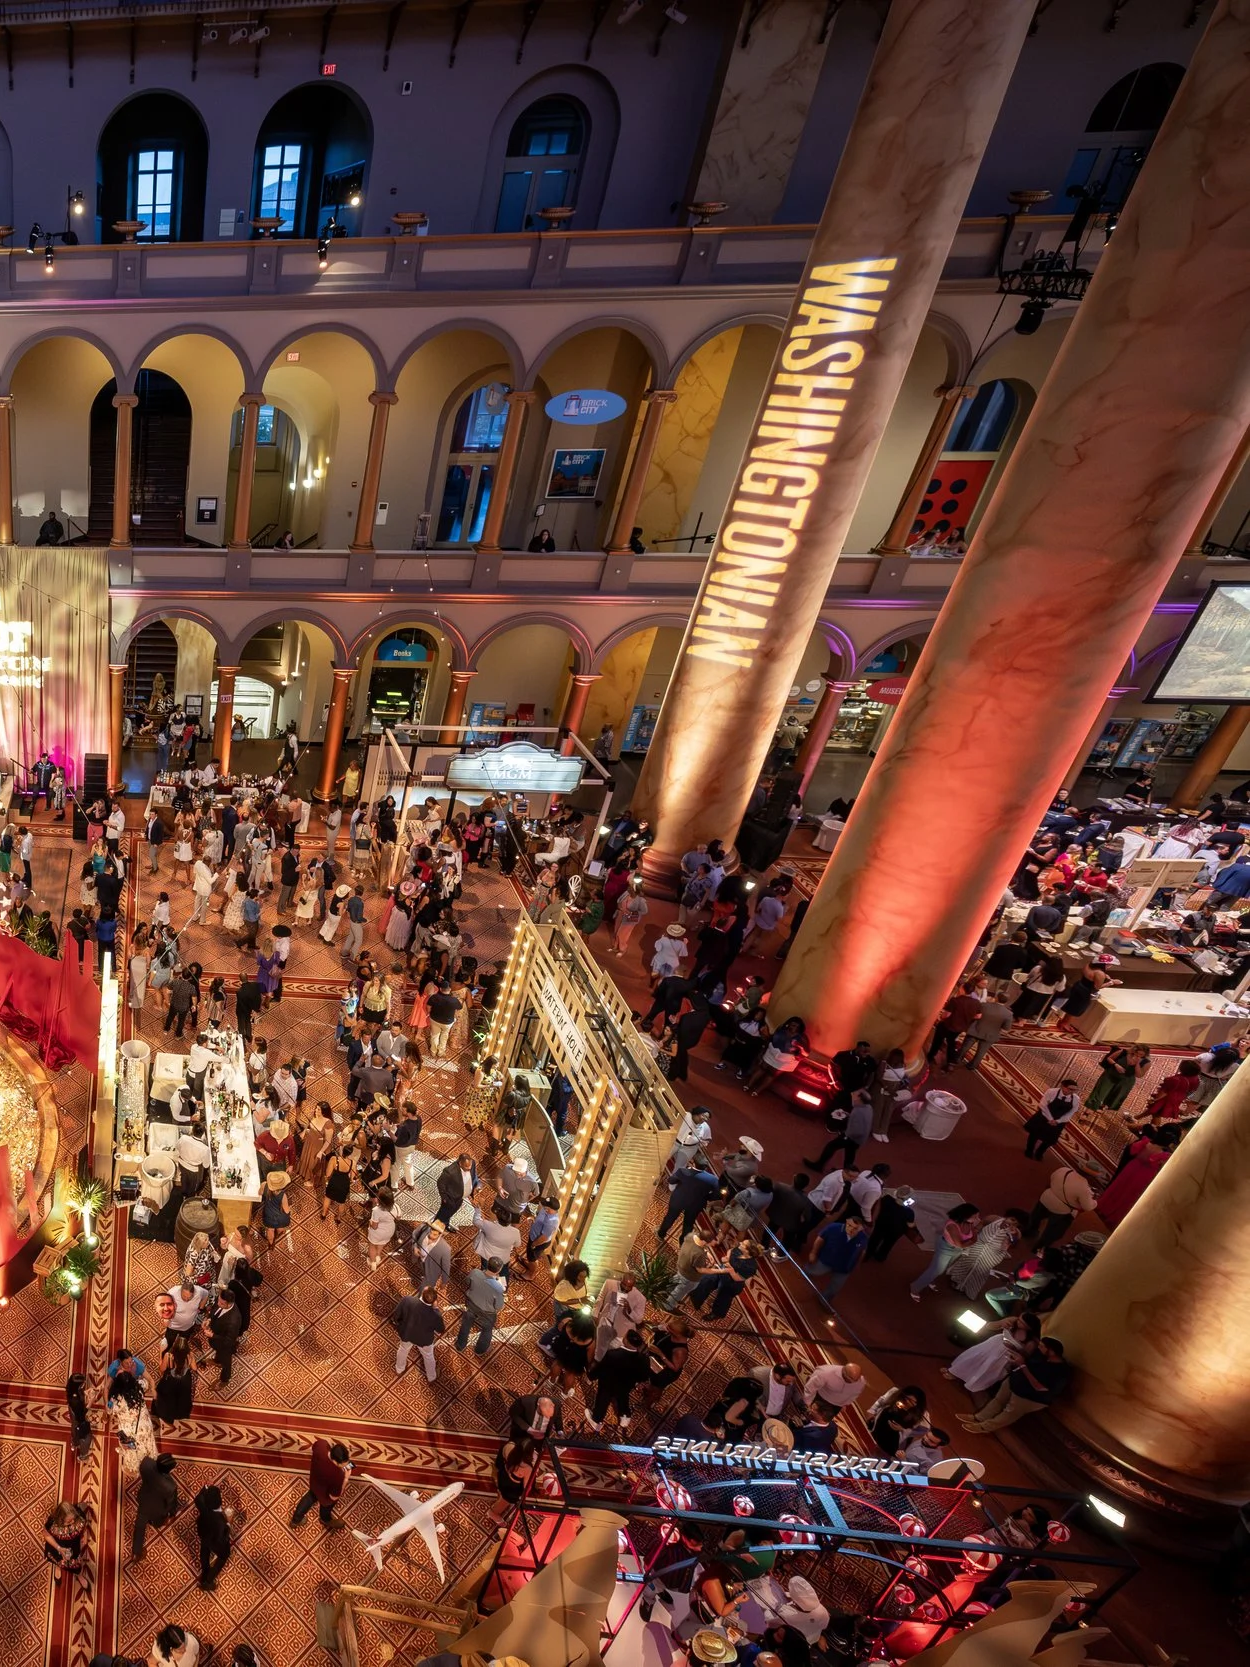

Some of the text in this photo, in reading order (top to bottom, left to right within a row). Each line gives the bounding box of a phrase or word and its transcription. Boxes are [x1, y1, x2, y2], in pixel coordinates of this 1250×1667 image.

[324, 64, 336, 75] EXIT
[686, 258, 898, 668] WASHINGTONIAN
[393, 649, 412, 657] Books
[493, 768, 532, 779] MGM
[566, 1030, 582, 1061] HOLE
